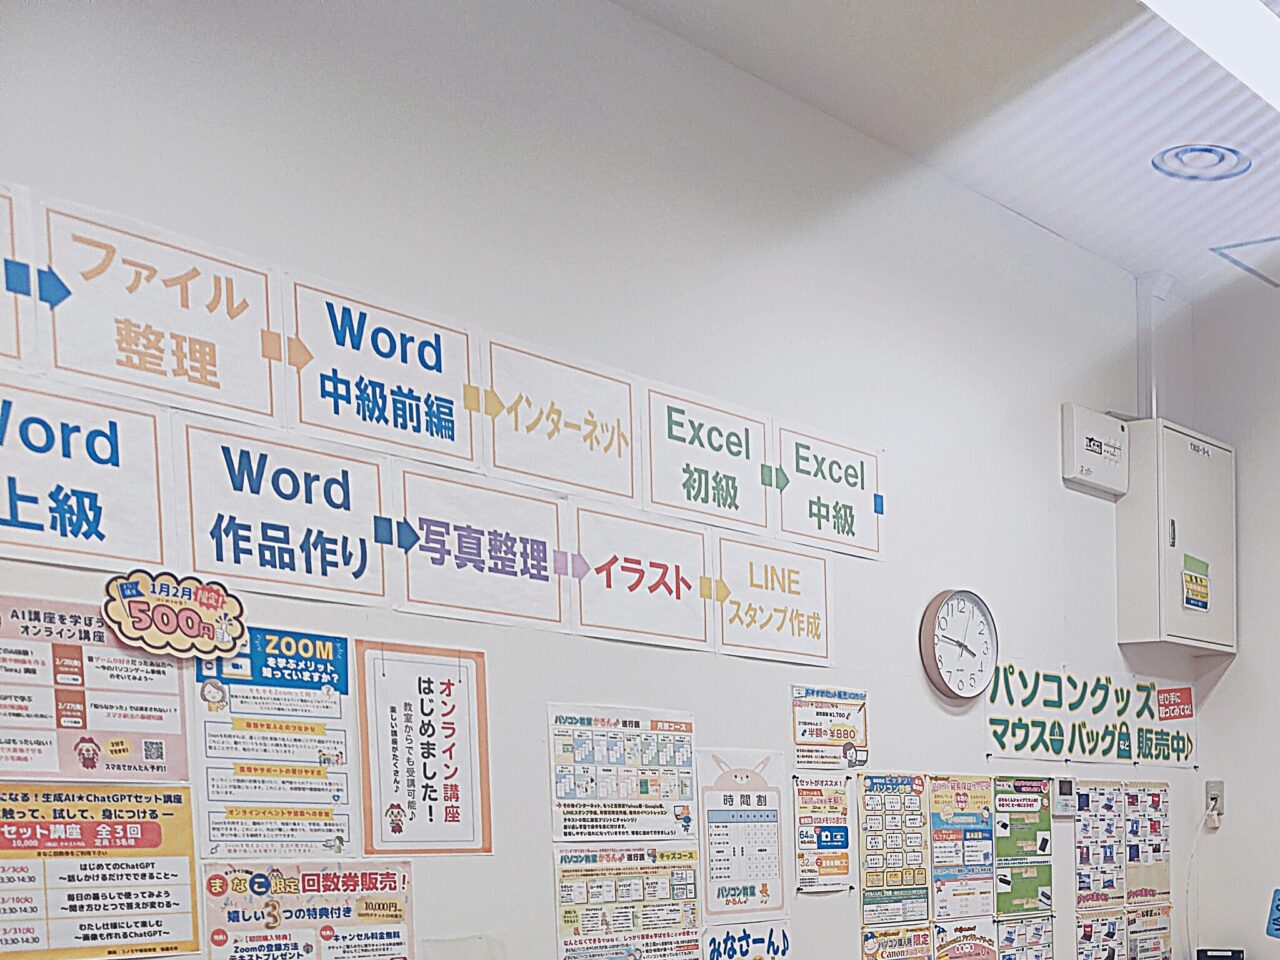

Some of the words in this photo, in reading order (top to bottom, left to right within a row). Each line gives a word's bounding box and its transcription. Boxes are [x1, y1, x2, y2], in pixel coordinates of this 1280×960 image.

[71, 233, 249, 320] ファイル
[114, 317, 221, 389] 整理
[325, 301, 443, 373] Word
[319, 367, 456, 442] 中級前編
[505, 392, 629, 458] インターネット
[0, 400, 120, 468] ord
[667, 405, 751, 460] Excel
[221, 445, 352, 511] Word
[682, 463, 740, 511] 初級
[794, 442, 866, 491] Excel
[0, 476, 106, 542] 上級
[808, 497, 856, 538] 中級
[209, 512, 368, 579] 作品作り
[418, 516, 550, 583] 写真整理
[595, 554, 692, 600] イラスト
[748, 561, 801, 596] LINE
[20, 624, 106, 643] オンライン講座
[128, 600, 215, 640] 500円
[265, 634, 334, 660] ZOOM
[728, 598, 821, 641] スタンプ作成
[978, 621, 985, 635] 2
[989, 664, 1157, 721] パソコングッズ
[417, 675, 439, 823] はじめました！
[438, 678, 461, 823] オンライン講座
[989, 717, 1050, 750] マウス
[1068, 722, 1117, 756] バッグ
[1137, 727, 1188, 762] 販売中
[1, 824, 82, 840] セット講座
[79, 861, 156, 871] はじめてのChatGPT
